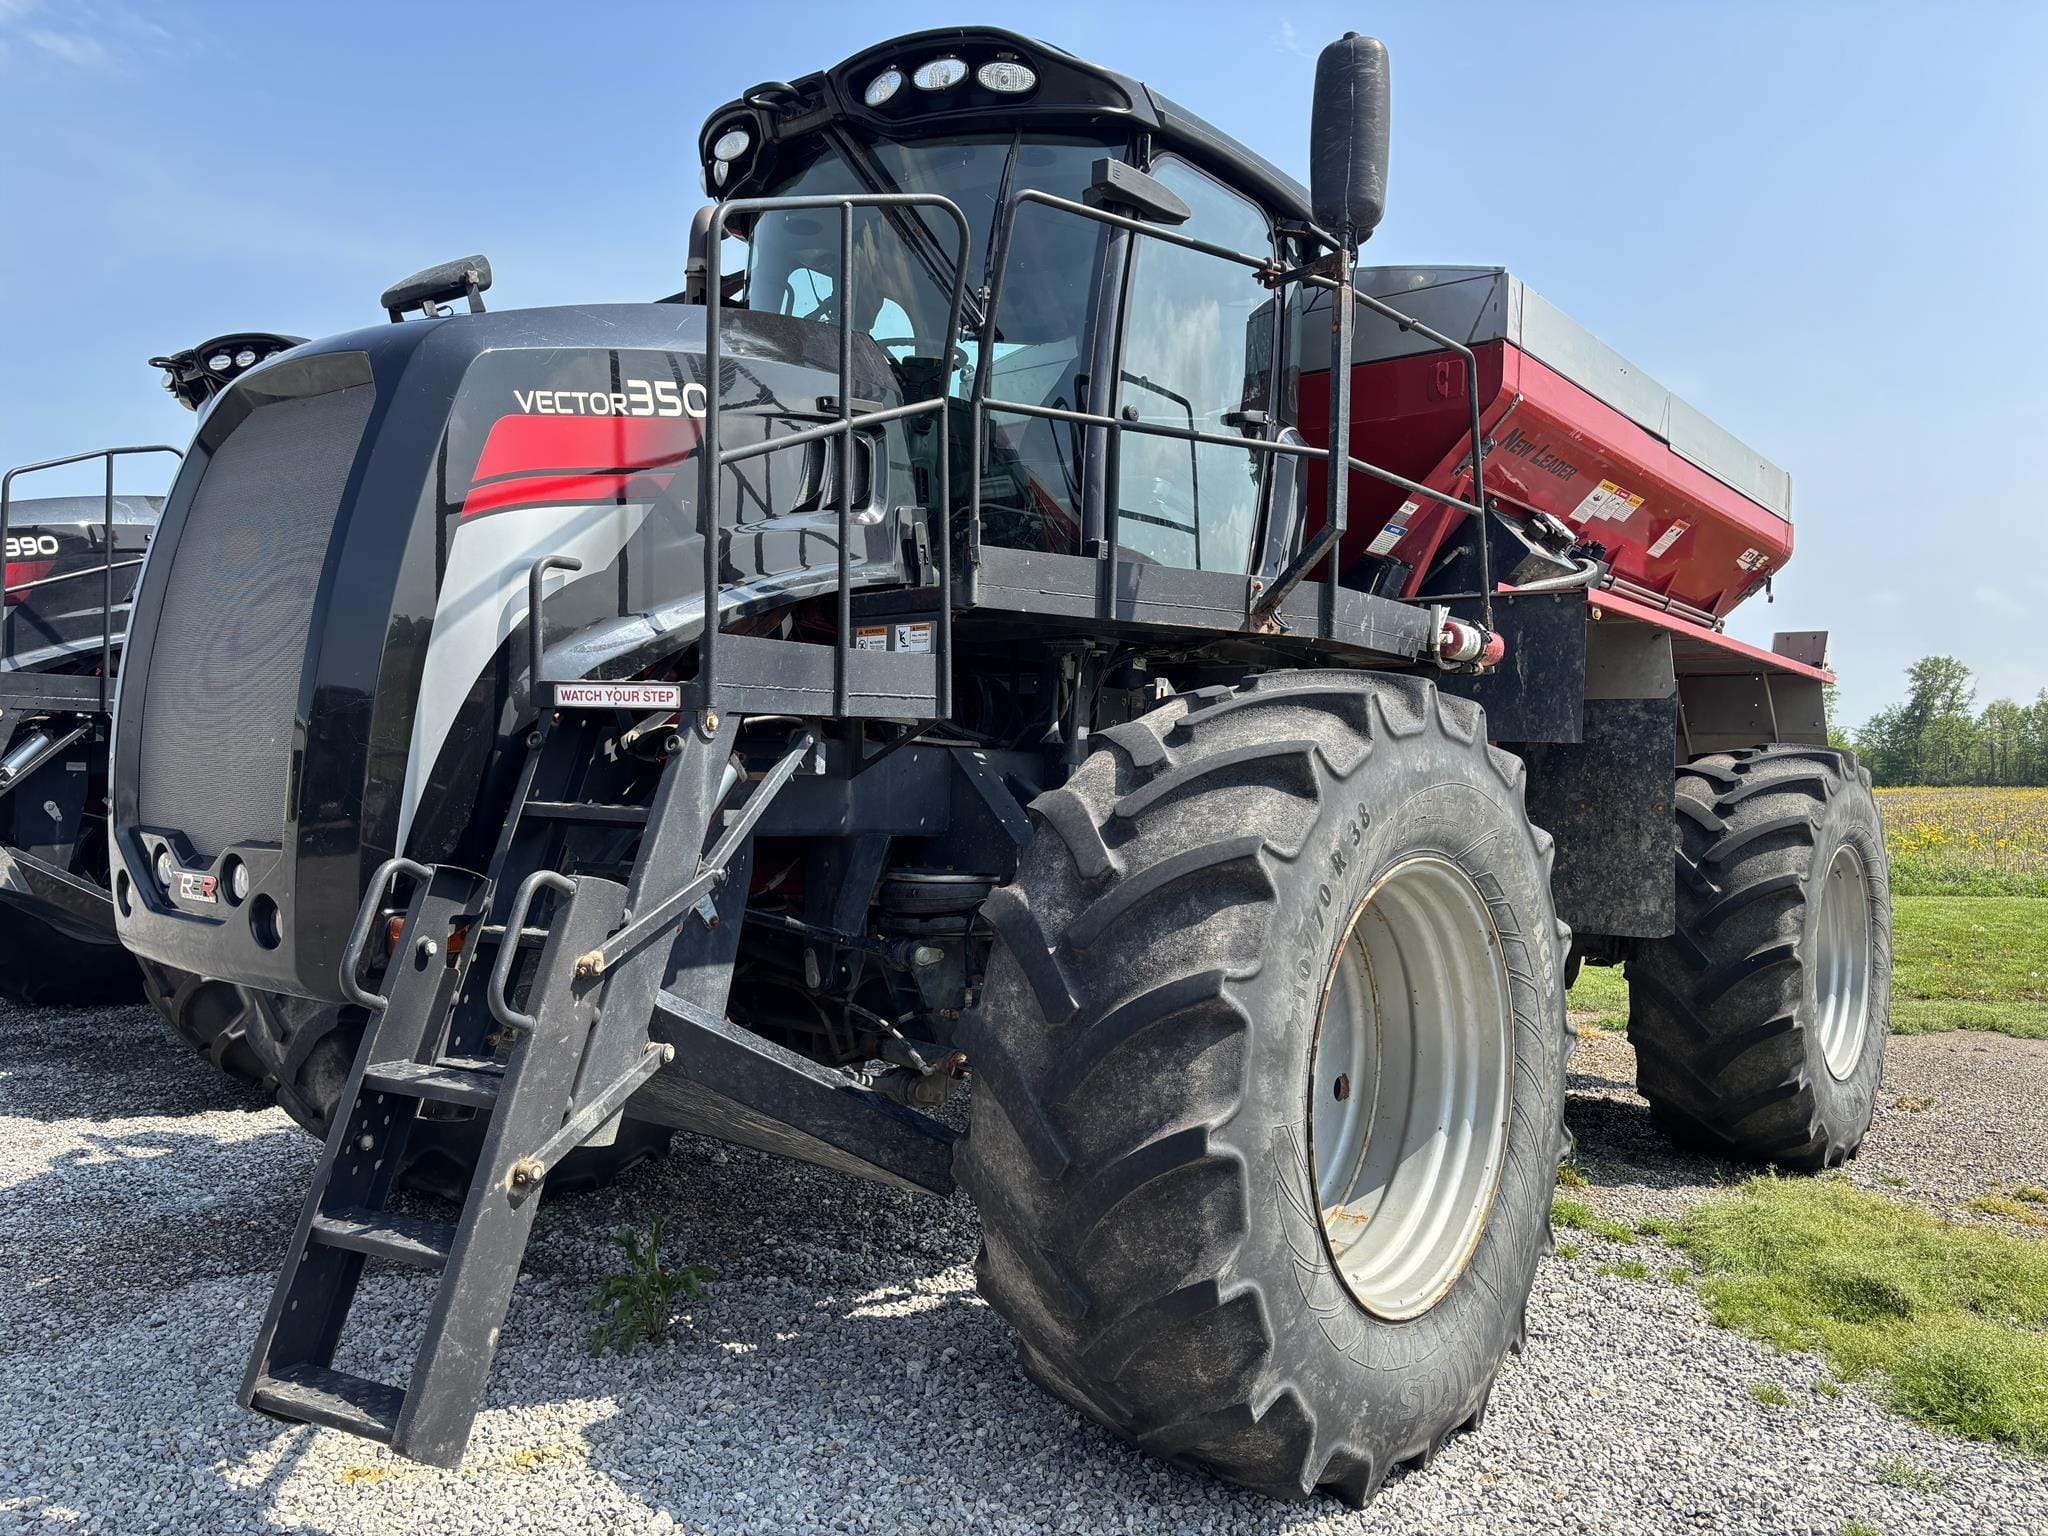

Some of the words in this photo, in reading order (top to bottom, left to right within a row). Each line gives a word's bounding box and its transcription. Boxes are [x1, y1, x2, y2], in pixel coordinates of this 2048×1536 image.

[5, 535, 59, 557] 390
[560, 690, 602, 702] WATCH
[605, 690, 640, 702] YOUR
[643, 691, 674, 703] STEP
[1330, 849, 1347, 878] R
[1348, 802, 1370, 847] 38
